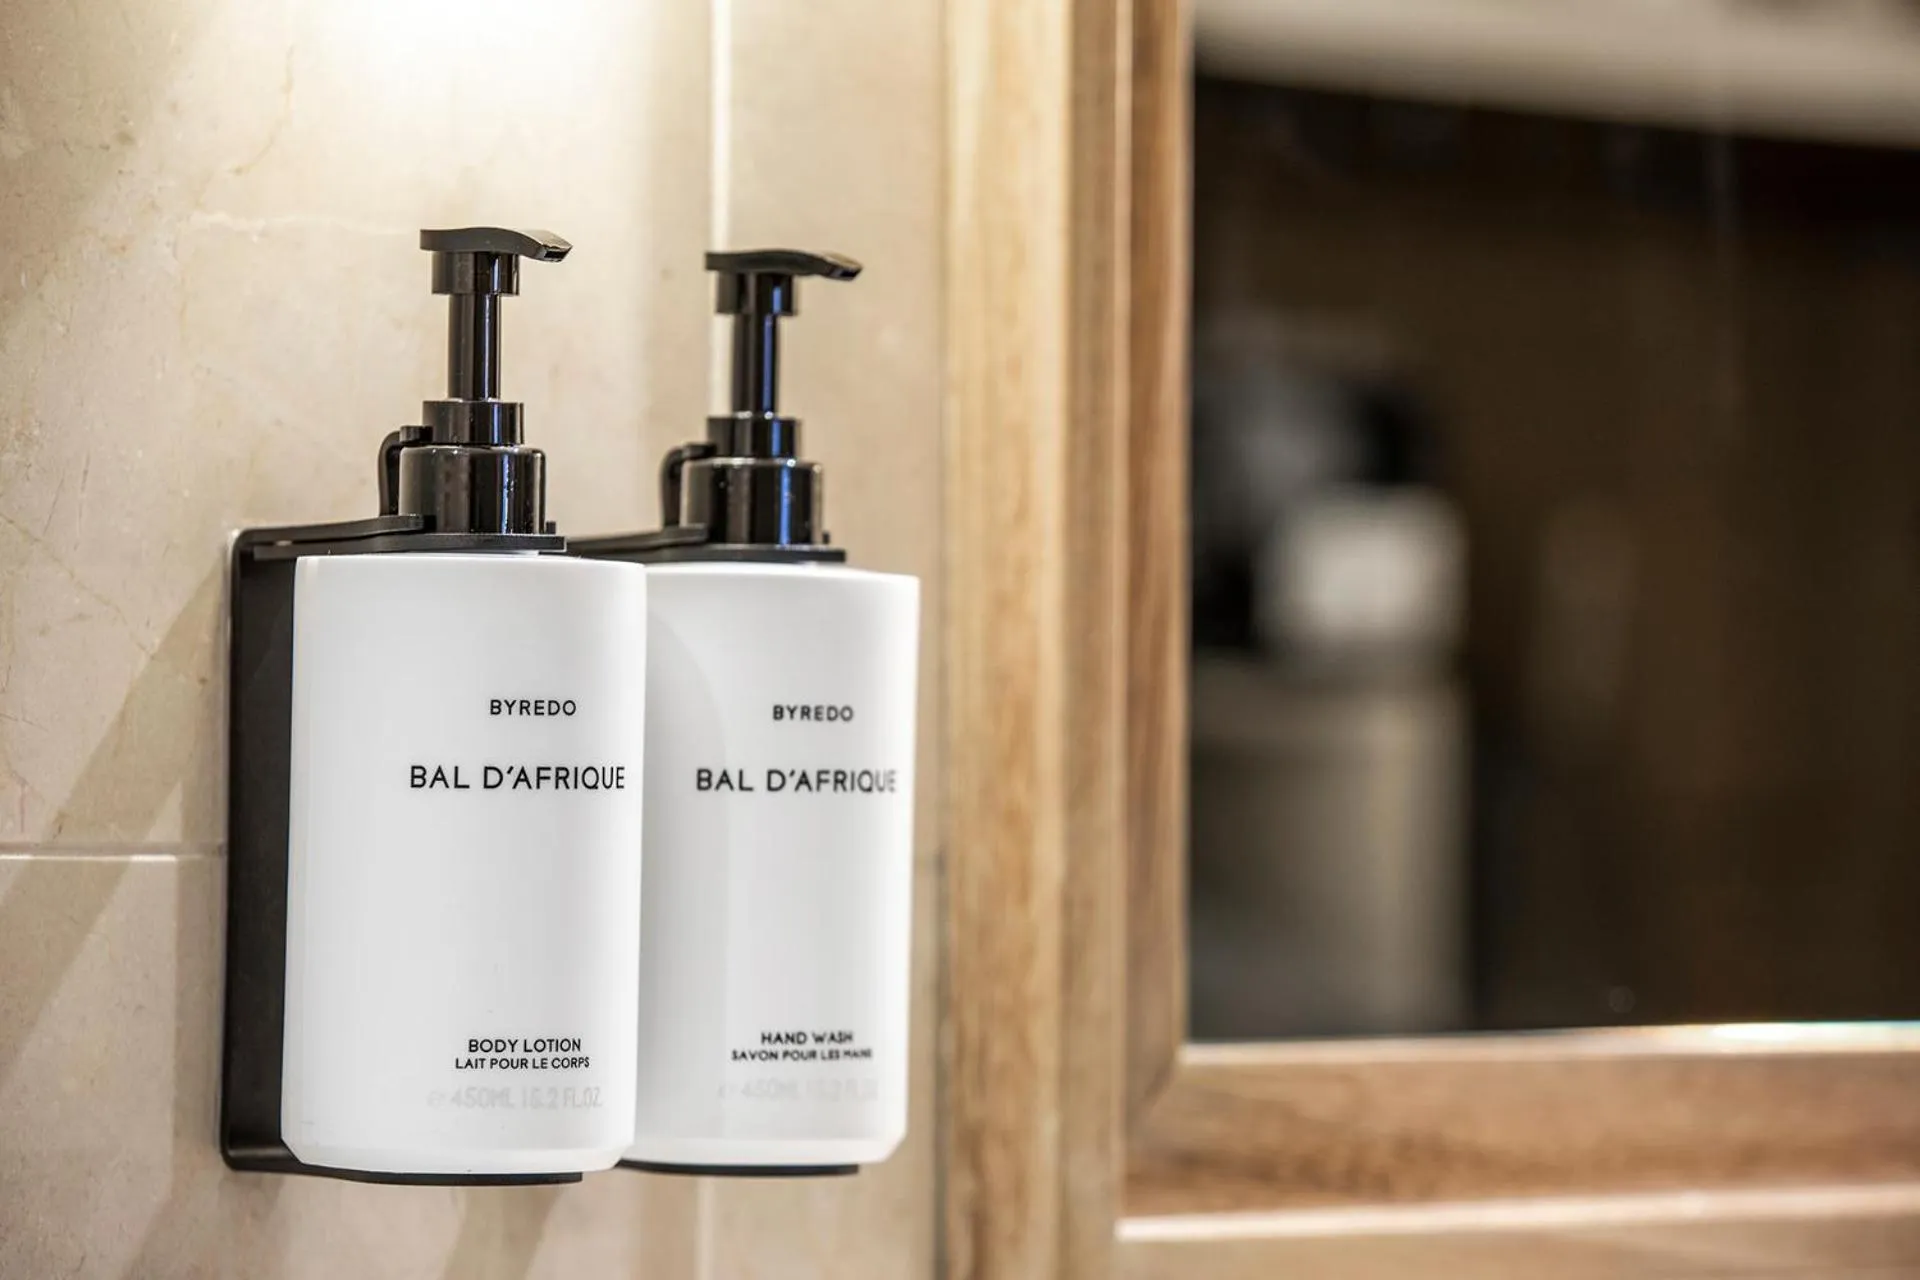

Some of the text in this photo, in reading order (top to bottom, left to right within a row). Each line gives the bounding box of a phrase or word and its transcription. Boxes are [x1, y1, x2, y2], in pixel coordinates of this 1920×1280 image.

[489, 698, 577, 717] BYREDO
[772, 703, 854, 723] BYREDO
[409, 764, 626, 791] BAL D'AFRIQUE
[695, 767, 897, 795] BAL D'AFRIQUE
[467, 1037, 582, 1053] BODY LOTION
[760, 1030, 854, 1045] HAND WASH
[454, 1055, 590, 1070] LAIT POUR LE CORPS
[731, 1048, 779, 1062] SAVON
[782, 1048, 817, 1062] POUR
